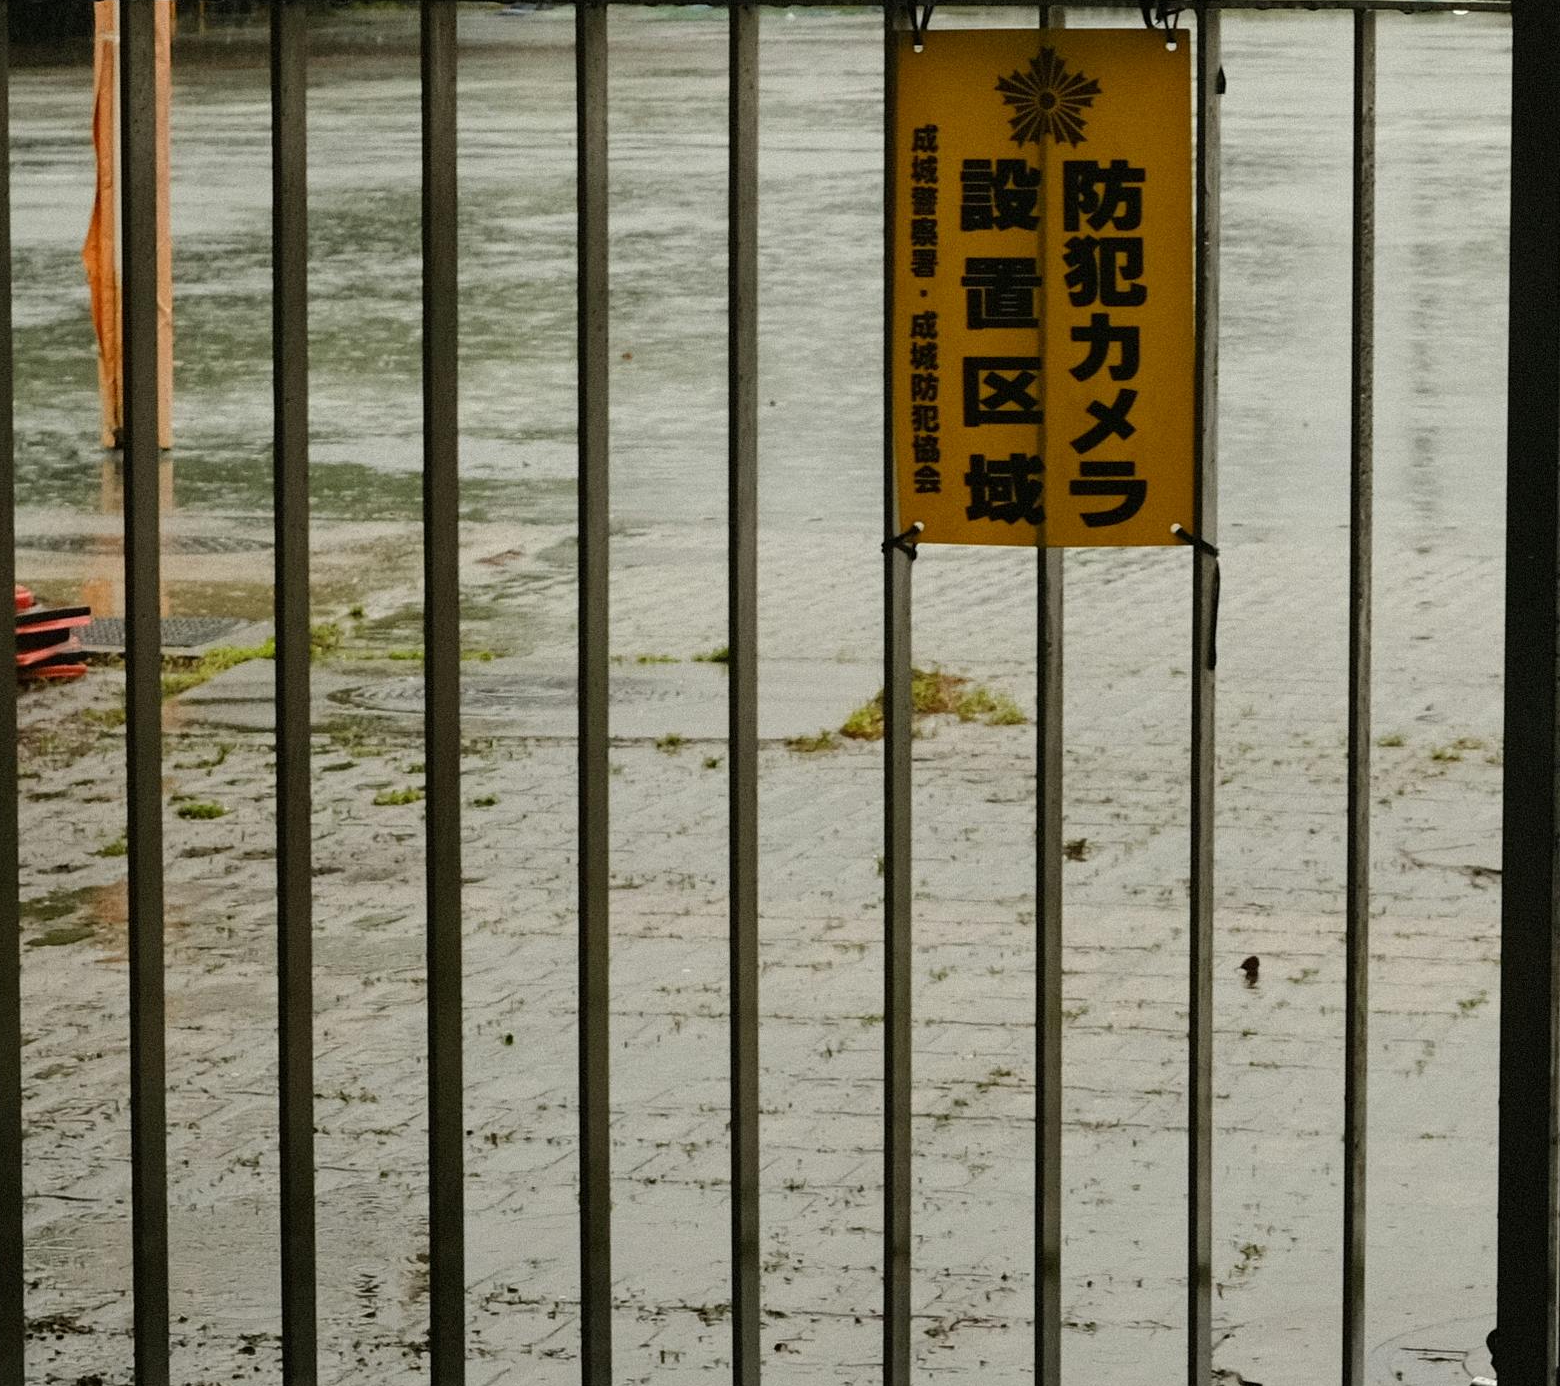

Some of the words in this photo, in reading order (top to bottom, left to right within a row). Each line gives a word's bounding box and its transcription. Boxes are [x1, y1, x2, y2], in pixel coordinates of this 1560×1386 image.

[959, 158, 1046, 526] 設置区域
[1062, 159, 1148, 528] 防犯カメラ
